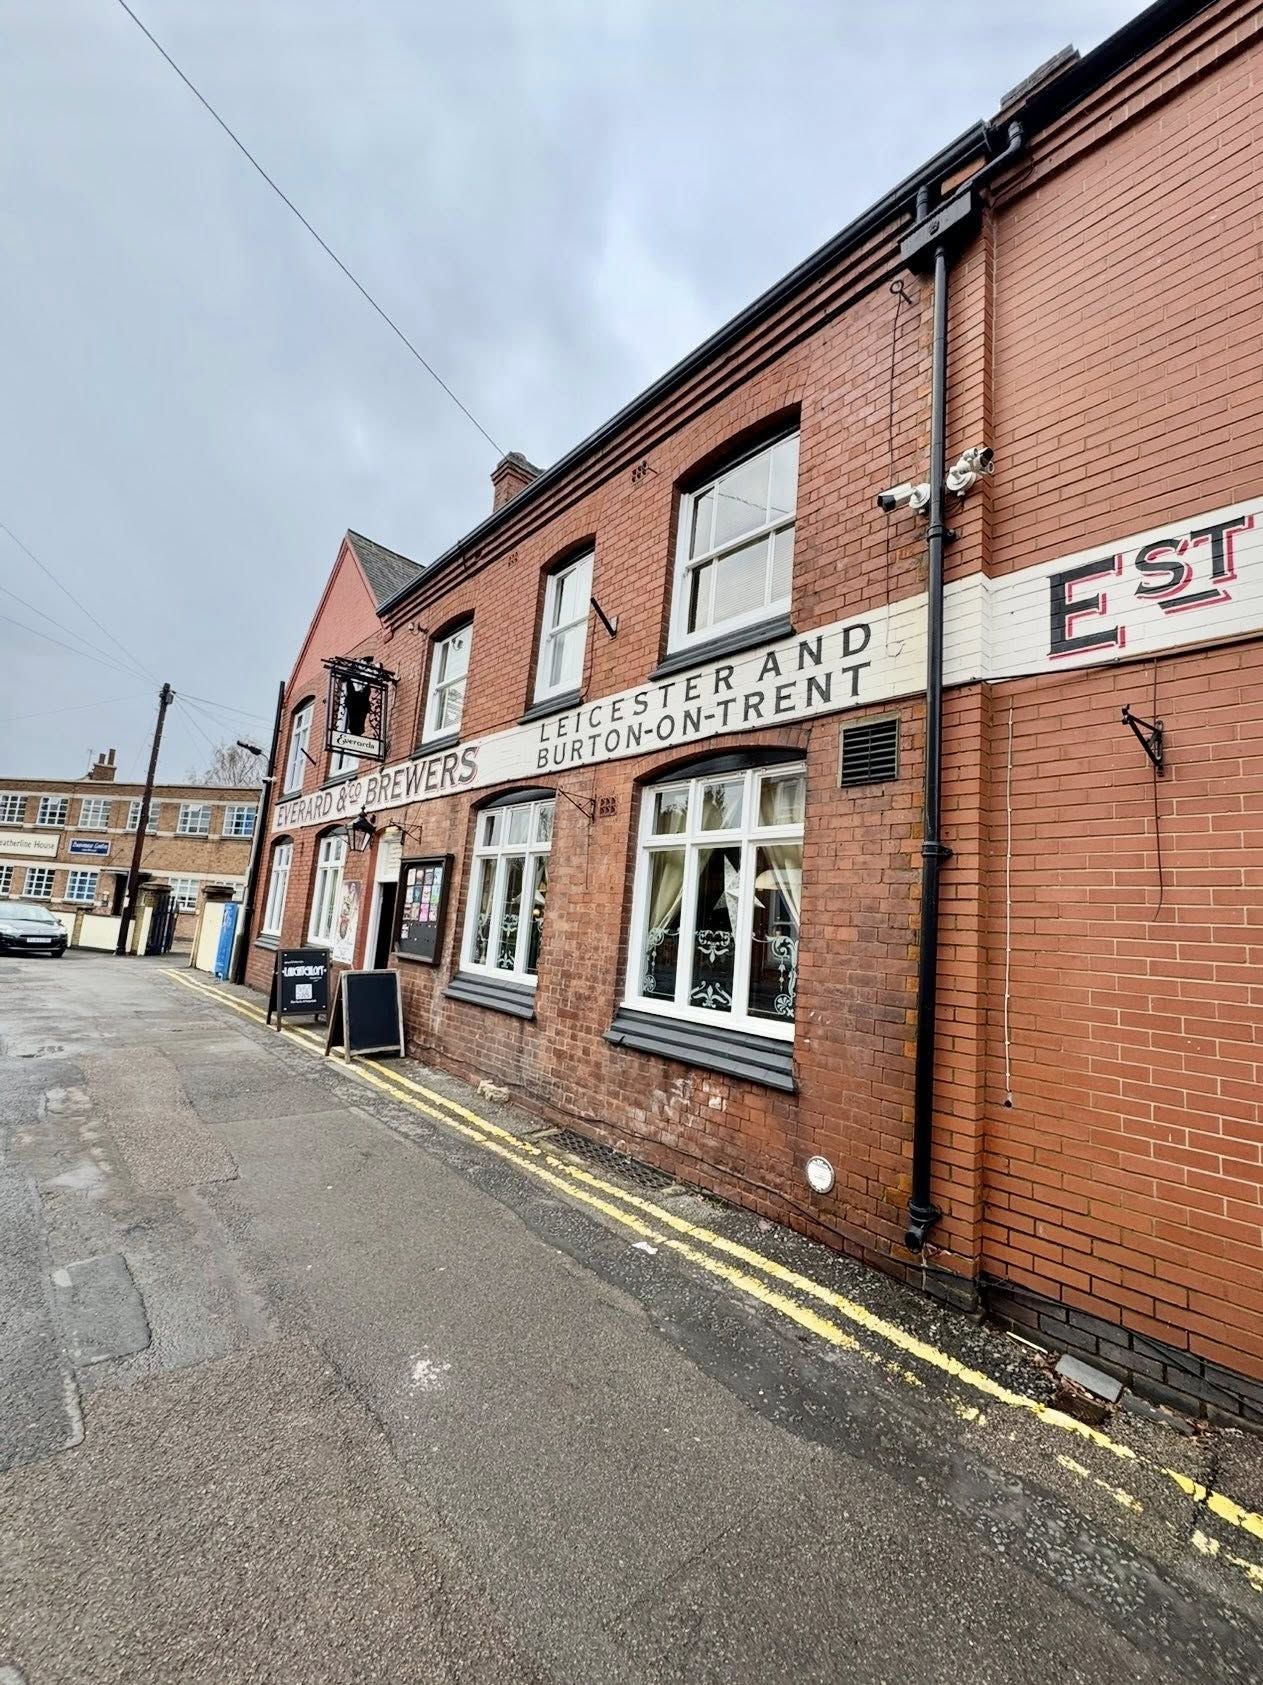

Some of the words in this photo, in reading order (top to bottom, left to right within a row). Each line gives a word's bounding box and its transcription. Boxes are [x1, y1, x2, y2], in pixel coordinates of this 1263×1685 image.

[536, 660, 871, 769] BURTON-ON-TRENT
[539, 665, 735, 743] LEICESTER
[757, 623, 871, 682] AND
[276, 791, 333, 827] EVERARD
[365, 746, 480, 807] BREWERS
[336, 733, 375, 750] Everards
